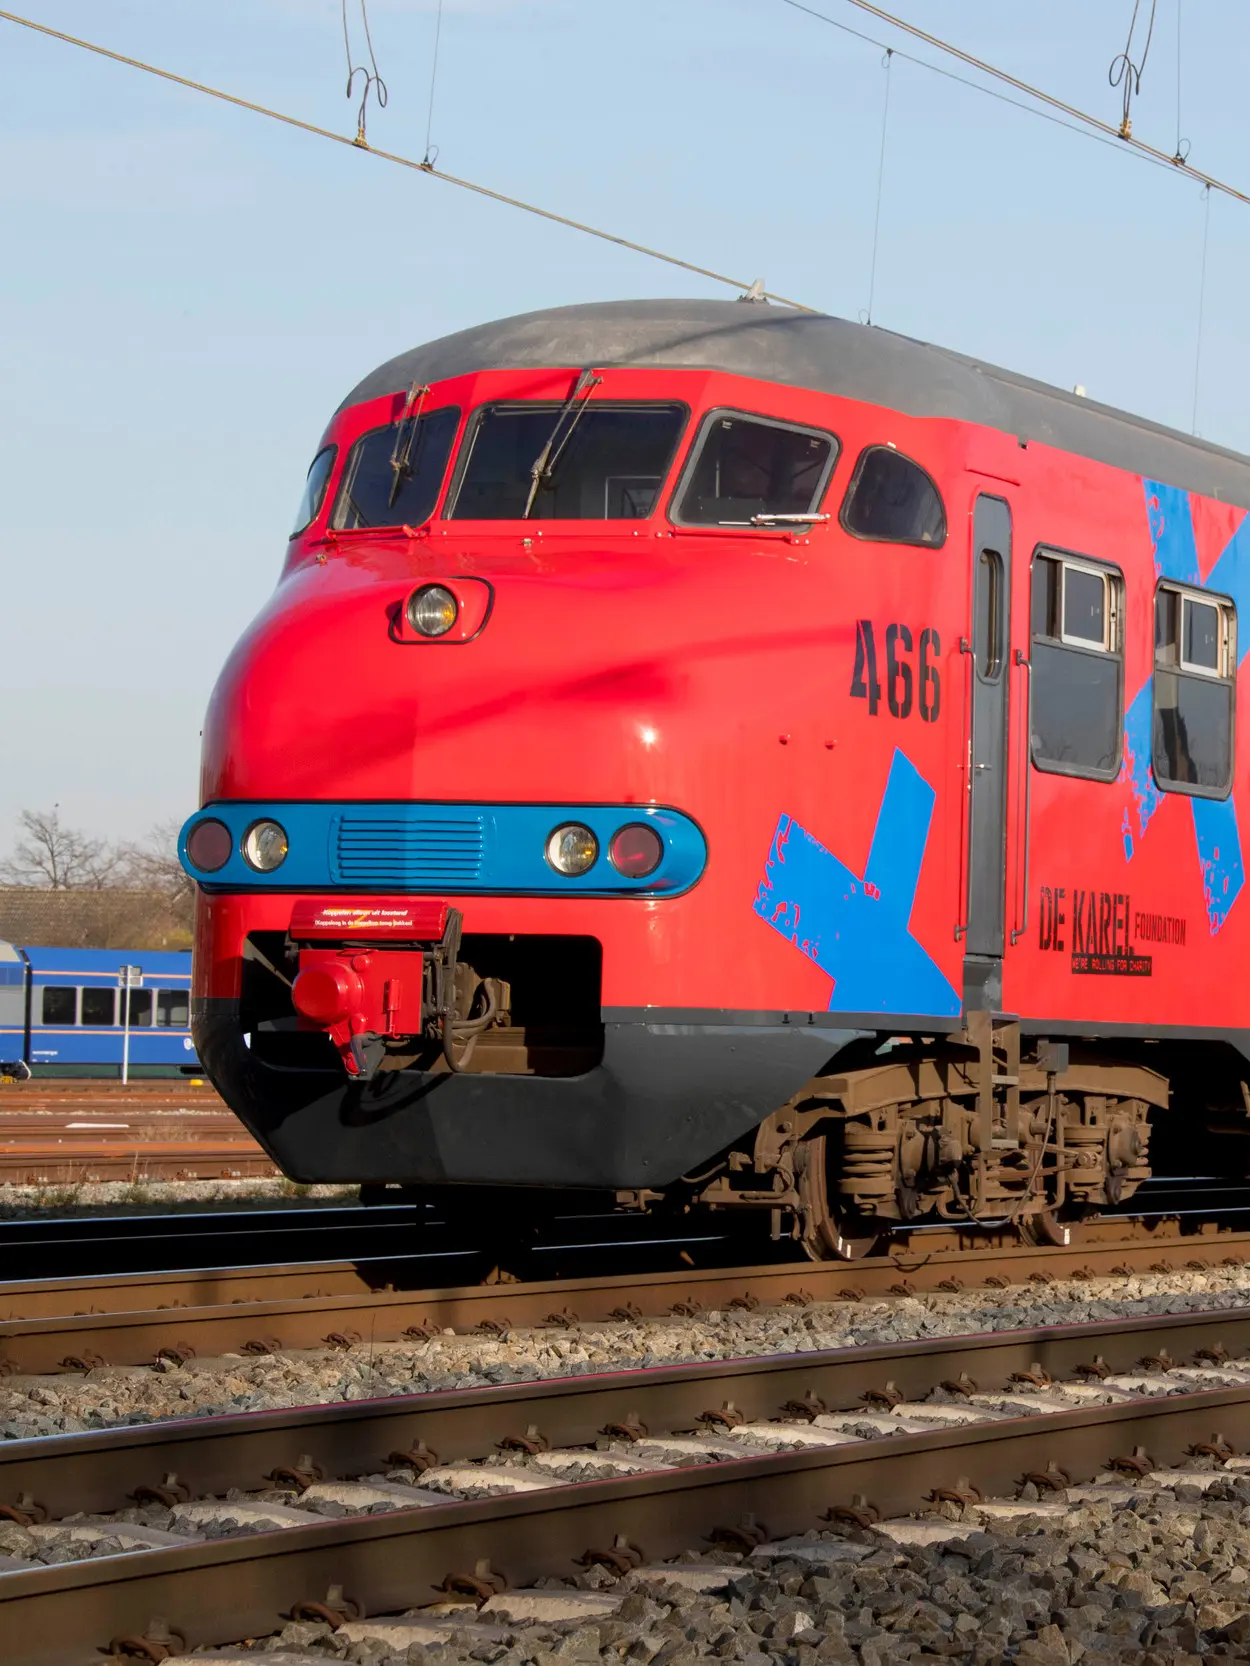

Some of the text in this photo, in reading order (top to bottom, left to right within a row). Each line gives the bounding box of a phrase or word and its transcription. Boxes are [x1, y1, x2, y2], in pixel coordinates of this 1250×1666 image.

[849, 618, 941, 723] 466
[1039, 886, 1186, 956] DE KAREL FOUNDATION
[1117, 958, 1127, 971] FOR
